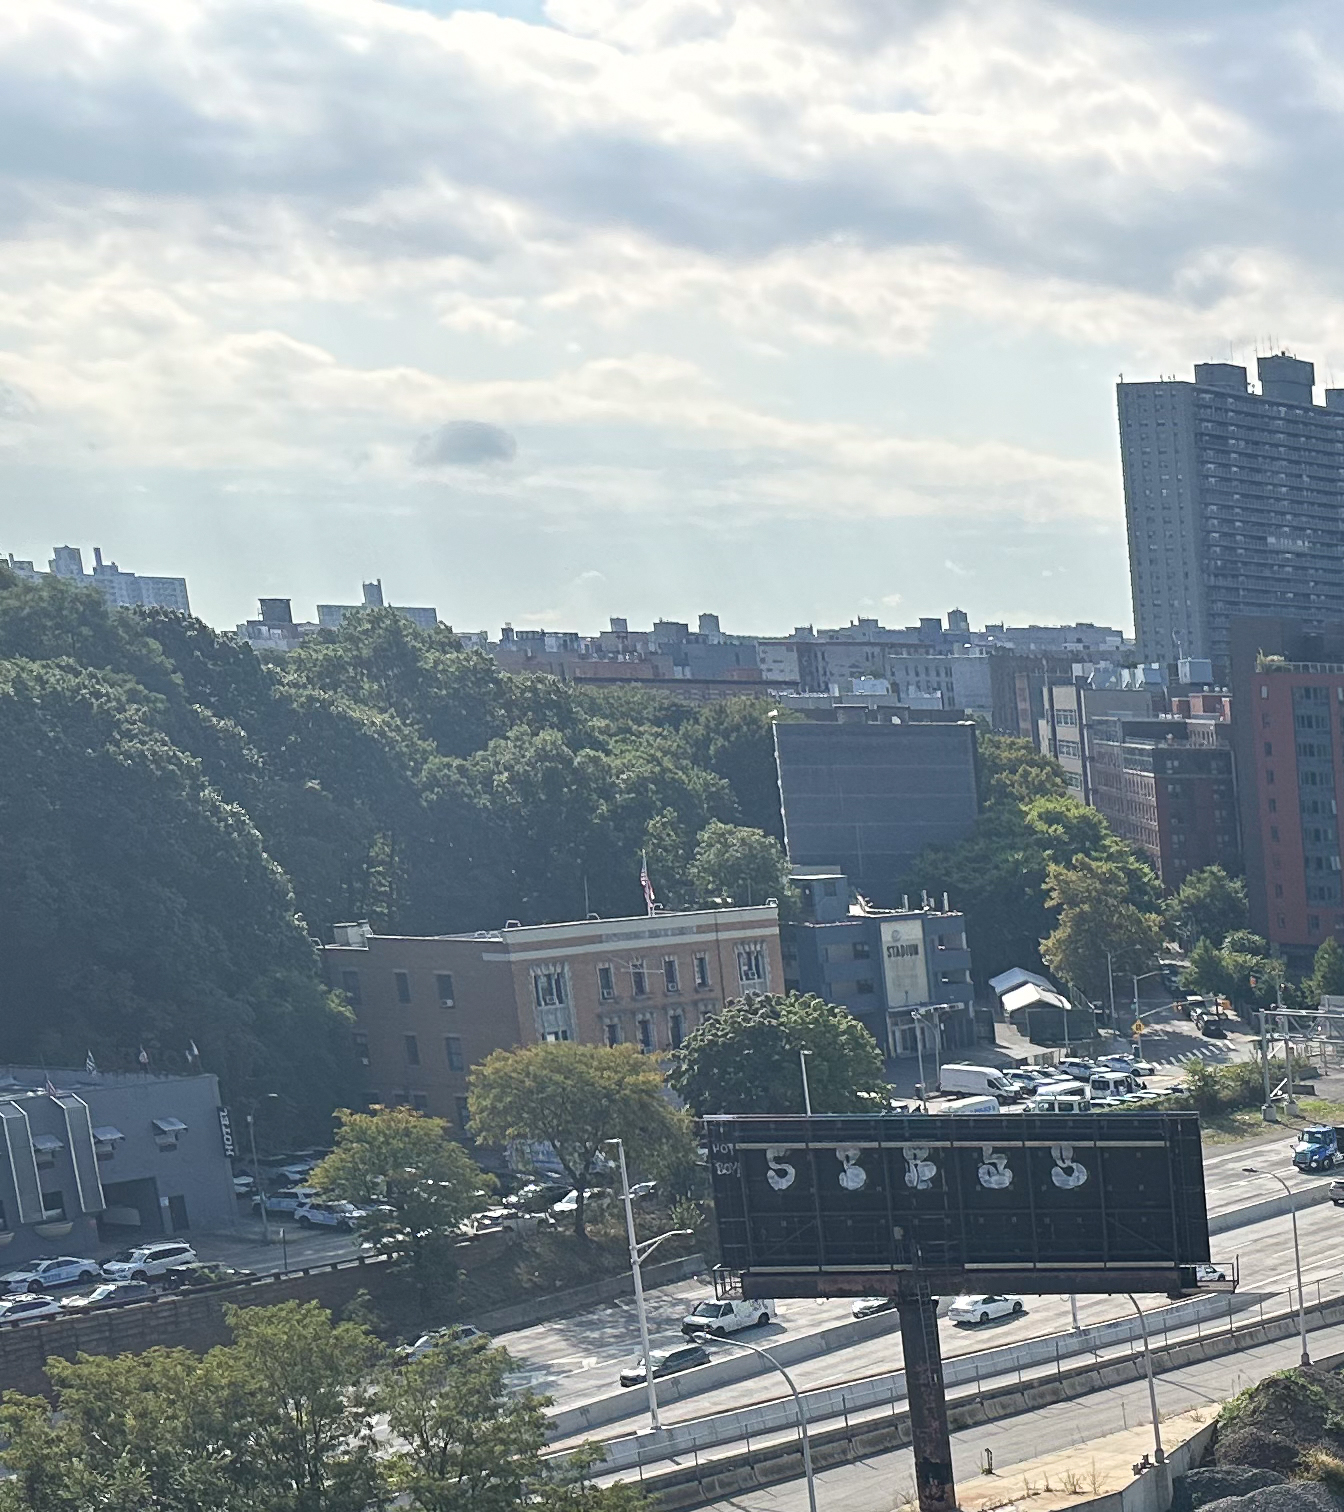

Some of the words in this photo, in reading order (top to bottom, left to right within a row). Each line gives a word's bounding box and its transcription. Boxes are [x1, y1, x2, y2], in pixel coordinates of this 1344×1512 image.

[886, 943, 919, 958] STADIUM
[220, 1107, 235, 1157] HOTEL
[712, 1143, 734, 1155] HOT
